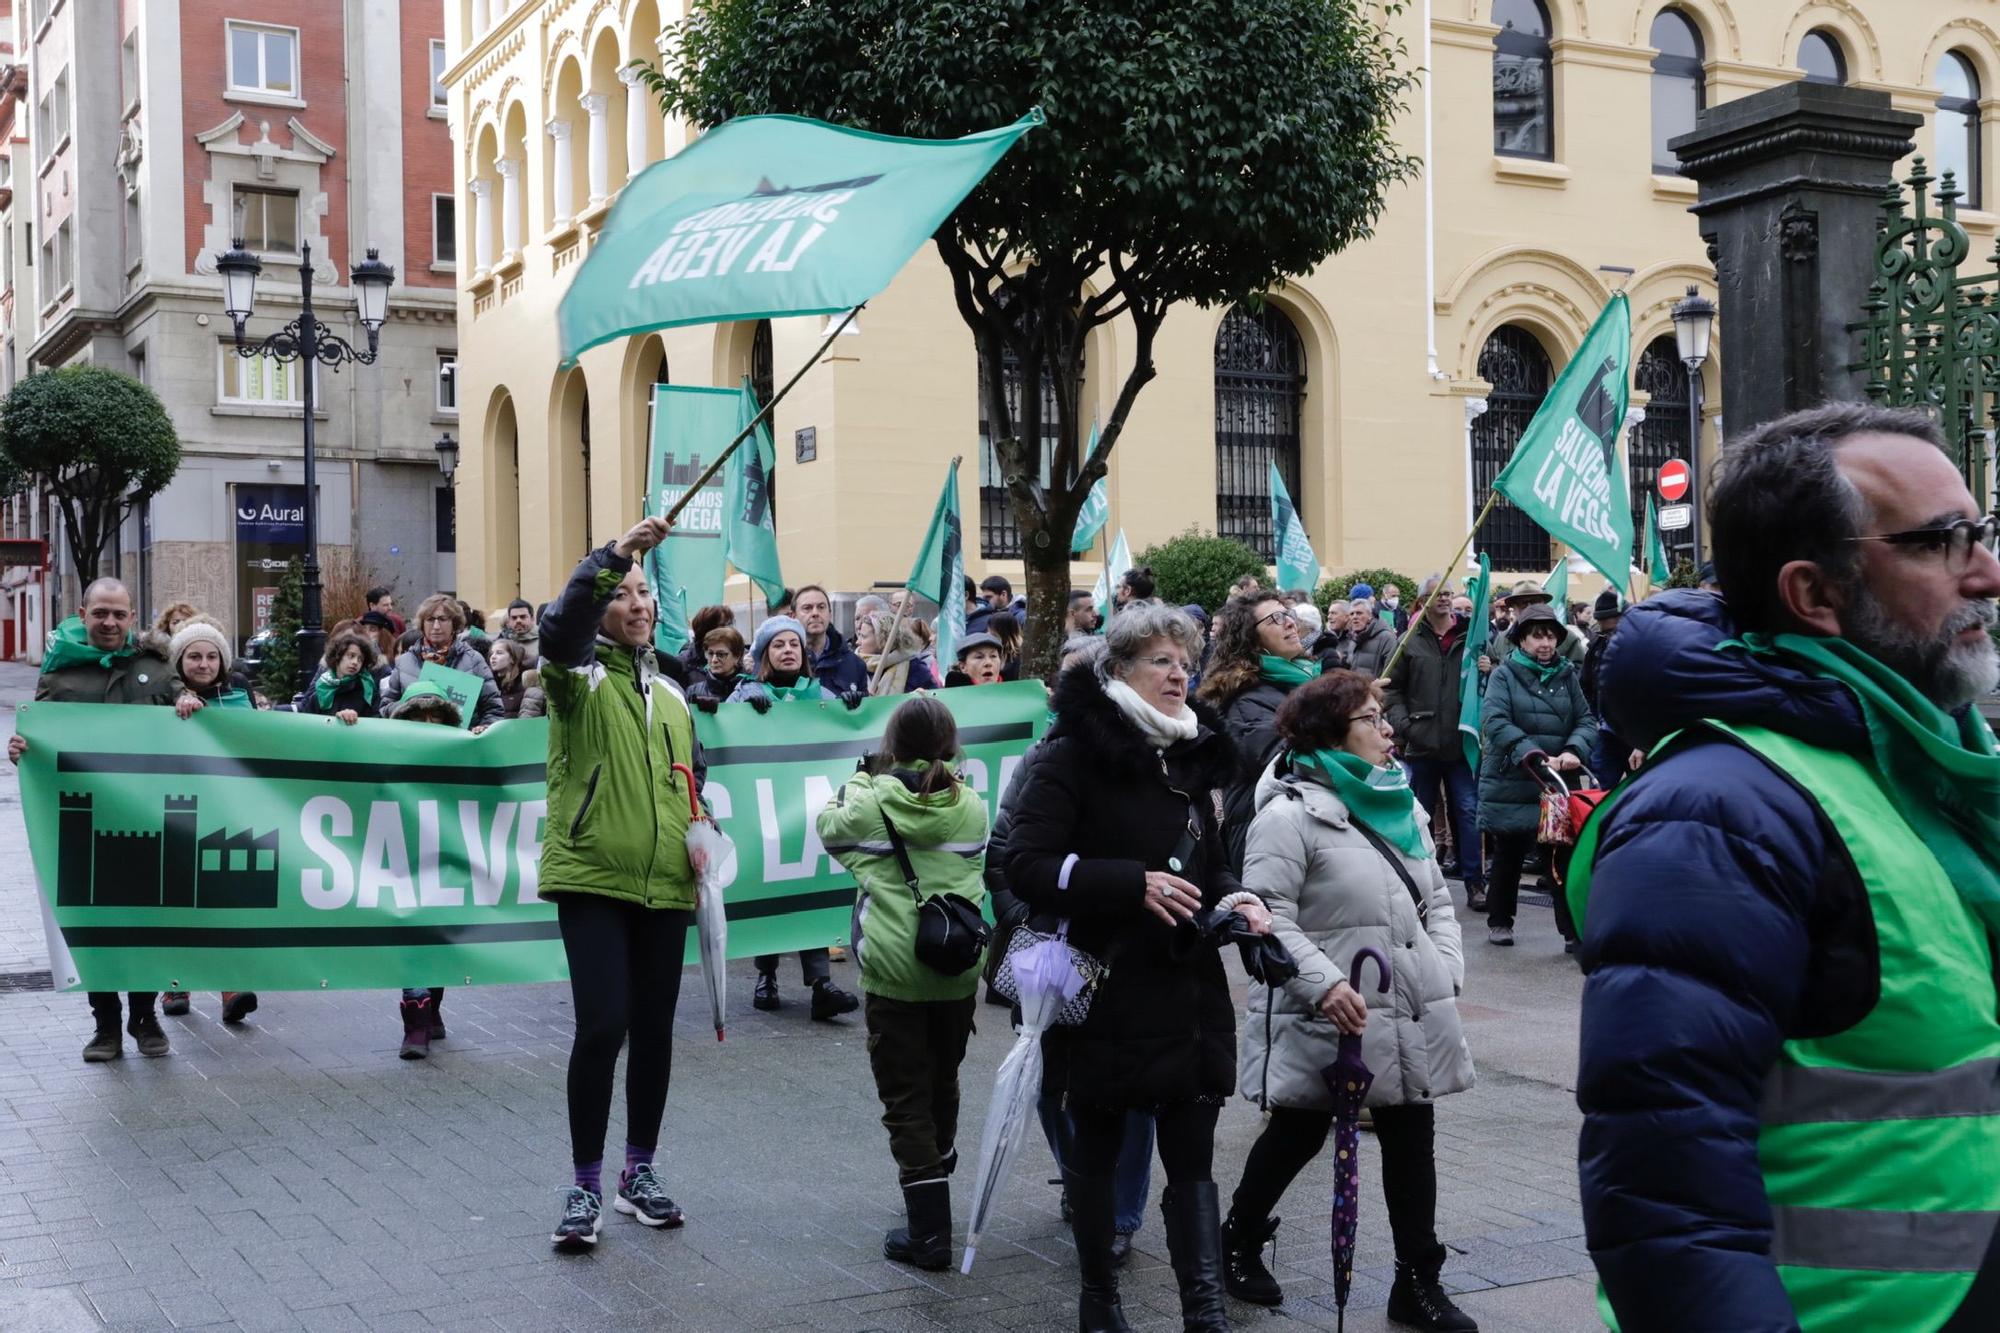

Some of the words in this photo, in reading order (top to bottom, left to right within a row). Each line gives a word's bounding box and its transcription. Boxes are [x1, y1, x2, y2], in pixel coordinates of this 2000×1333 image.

[1533, 450, 1565, 510] LA
[1560, 476, 1620, 550] VEGA
[1554, 418, 1612, 512] SALVEMO
[260, 504, 304, 521] Aural
[680, 507, 723, 530] VEGA
[300, 781, 738, 911] SALVES
